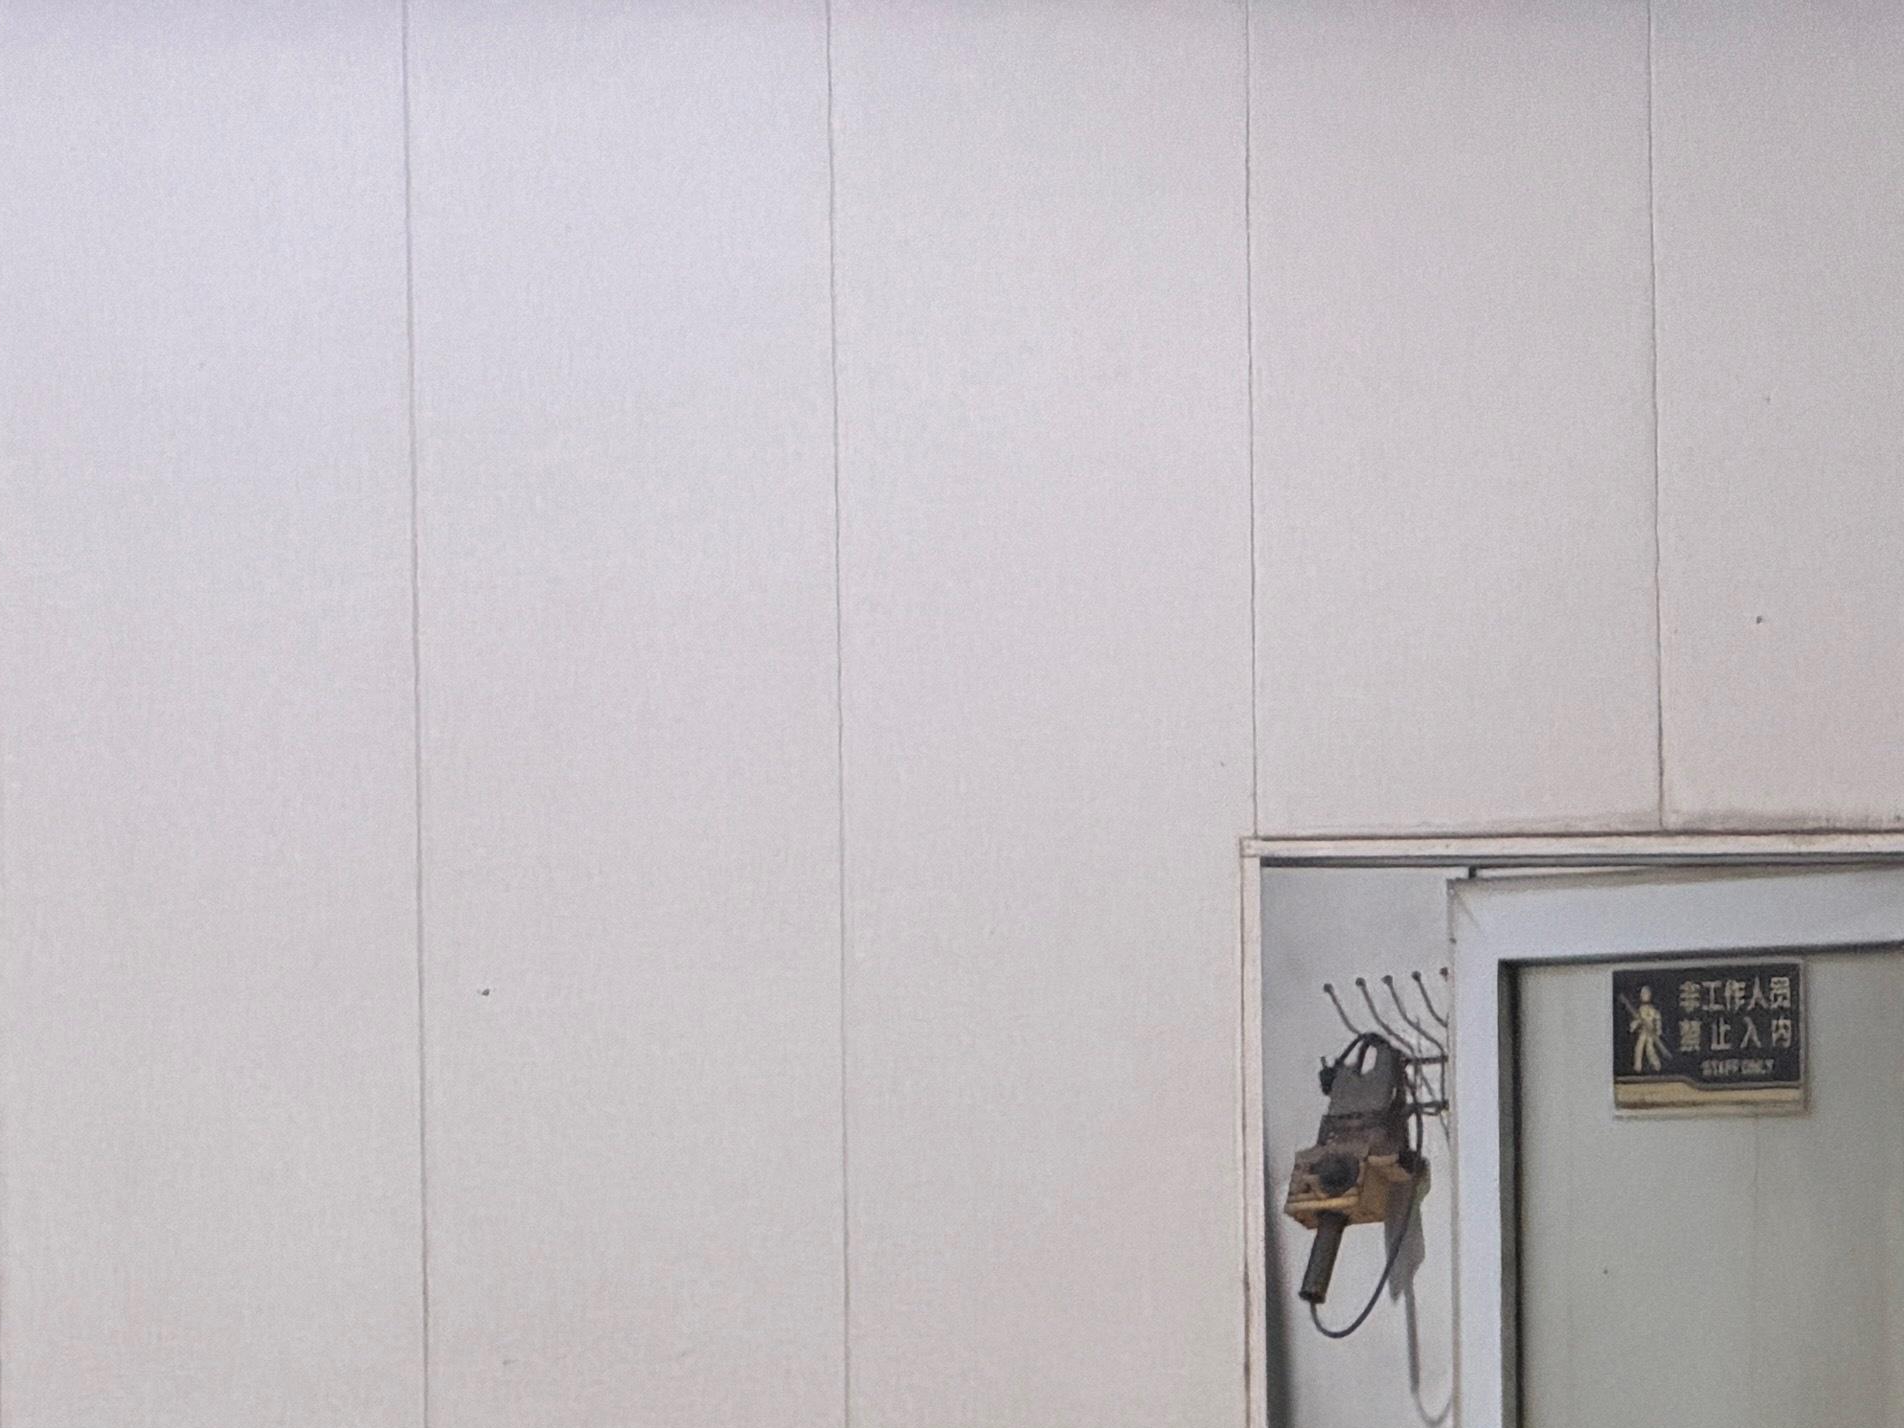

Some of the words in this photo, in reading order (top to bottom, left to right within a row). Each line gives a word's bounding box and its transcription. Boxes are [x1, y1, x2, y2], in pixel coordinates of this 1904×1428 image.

[1679, 976, 1791, 1012] 非工作人员
[1679, 1017, 1792, 1051] 禁止入内
